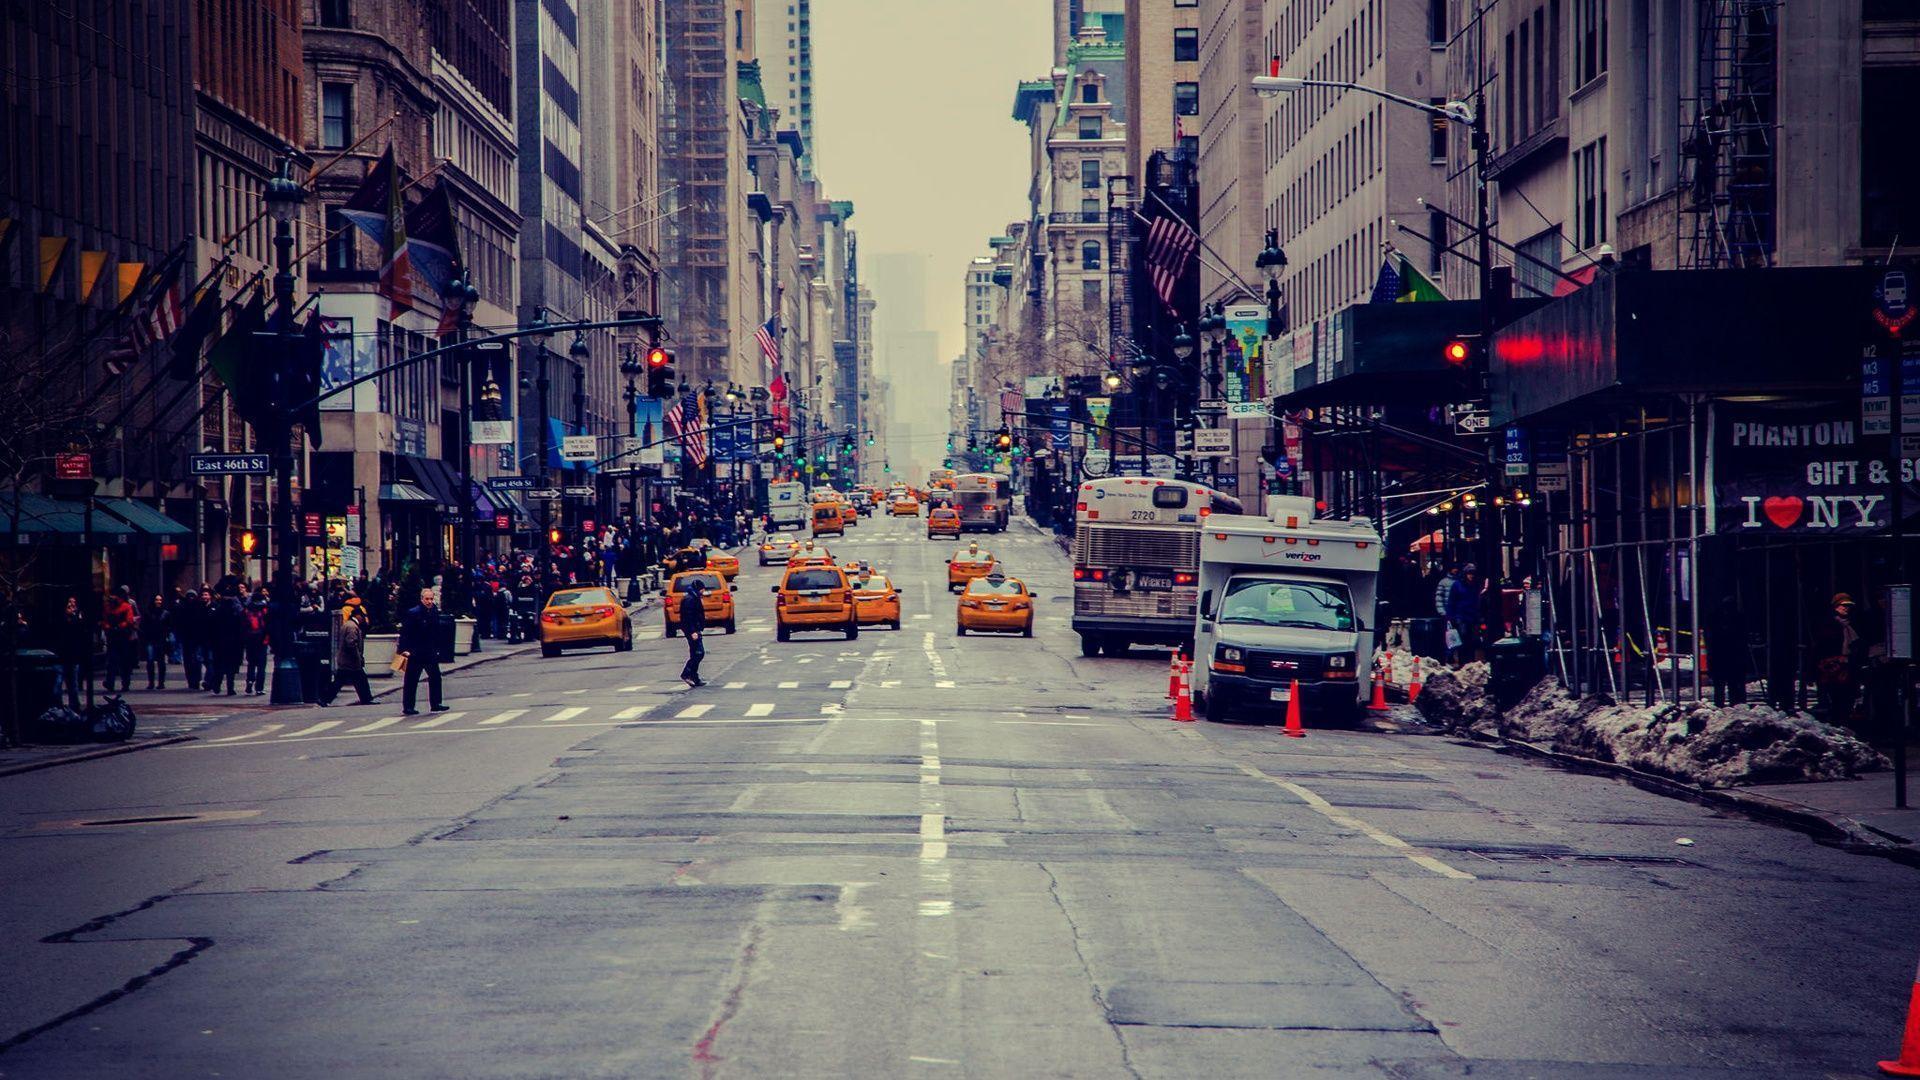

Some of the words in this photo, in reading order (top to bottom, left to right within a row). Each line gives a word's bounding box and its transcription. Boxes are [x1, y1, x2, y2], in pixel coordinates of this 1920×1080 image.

[1863, 344, 1877, 358] M2
[1863, 361, 1878, 375] M3
[1863, 380, 1879, 394] M5
[1465, 417, 1486, 428] ONE
[1506, 428, 1519, 438] M1
[1732, 420, 1855, 447] PHANTOM
[1506, 441, 1519, 450] M4
[196, 460, 221, 471] East
[224, 459, 249, 470] 46th
[251, 458, 264, 469] St
[1806, 460, 1859, 486] GIFT
[1868, 459, 1891, 484] &
[492, 480, 507, 488] East
[524, 479, 533, 487] St
[1131, 510, 1155, 520] 2720
[1741, 495, 1762, 528] I
[1806, 494, 1886, 528] NY
[1285, 551, 1321, 562] verizon
